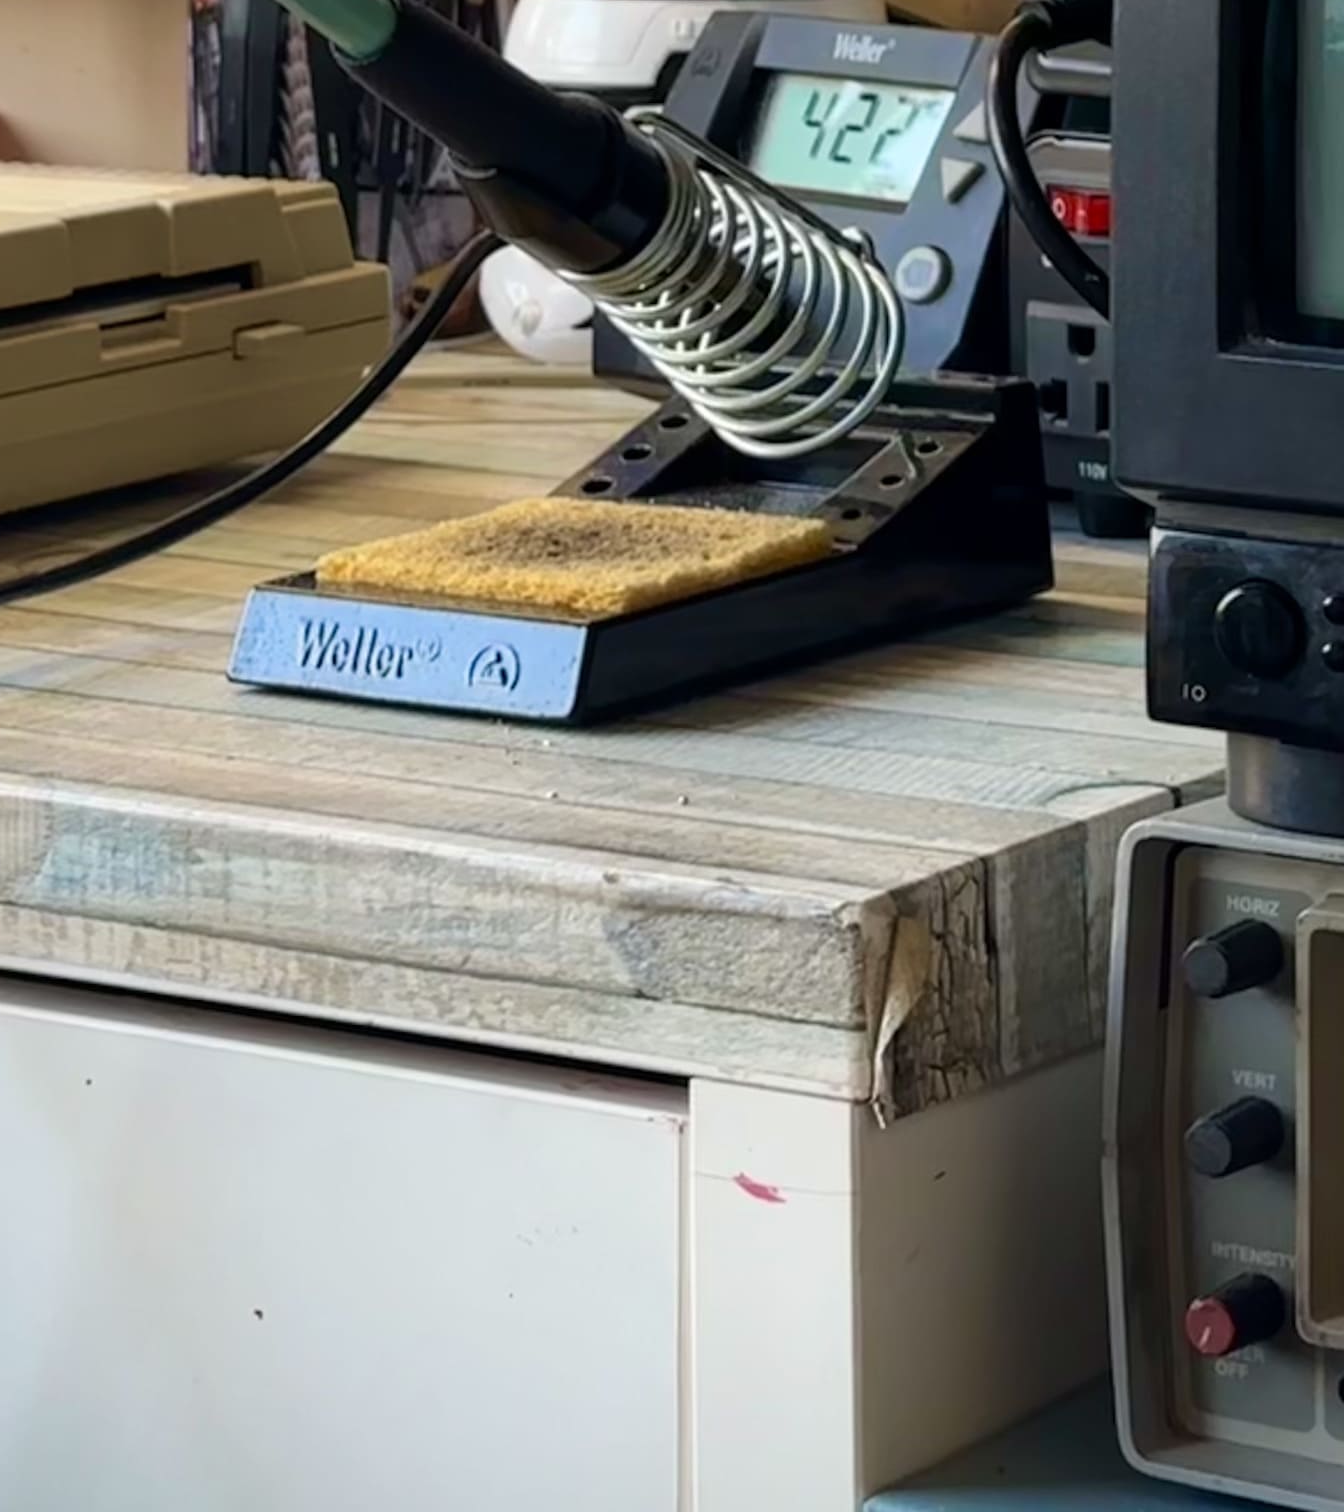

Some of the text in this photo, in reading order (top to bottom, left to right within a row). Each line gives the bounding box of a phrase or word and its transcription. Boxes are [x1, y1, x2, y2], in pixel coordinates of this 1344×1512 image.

[803, 91, 921, 164] 422
[1226, 894, 1281, 917] HORIZ
[1231, 1069, 1277, 1091] VERT
[1214, 1359, 1248, 1379] OFF
